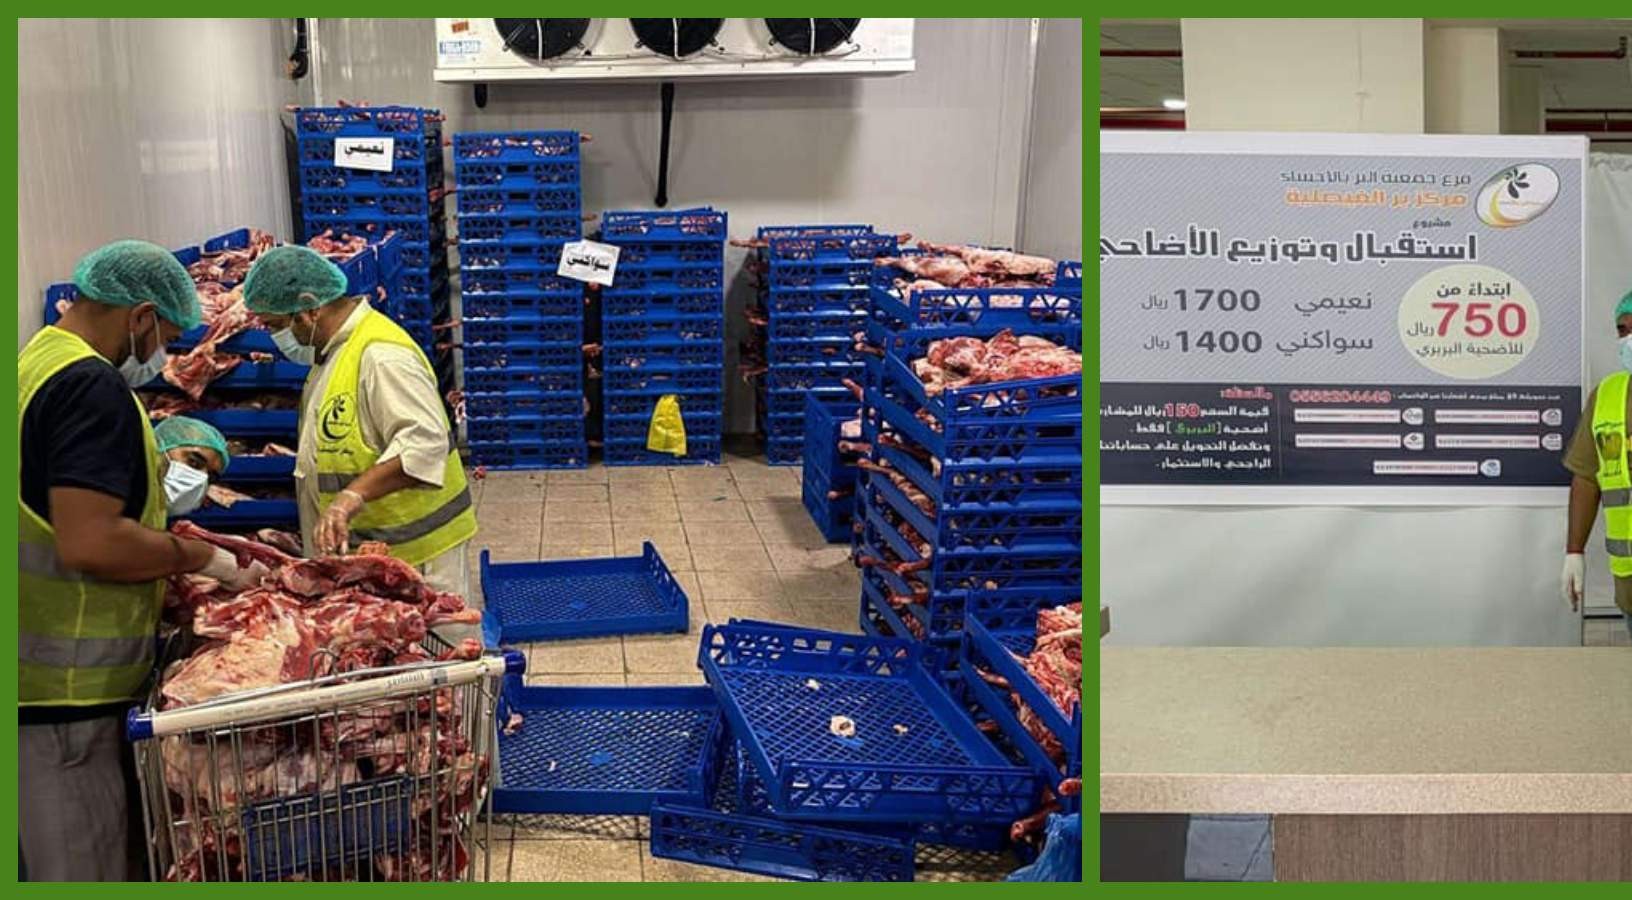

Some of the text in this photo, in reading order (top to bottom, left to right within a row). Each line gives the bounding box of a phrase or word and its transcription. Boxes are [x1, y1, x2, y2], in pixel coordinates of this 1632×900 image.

[1415, 188, 1468, 208] مركز
[1227, 236, 1339, 264] وتوزيع
[1344, 231, 1478, 265] استقبال
[1140, 288, 1373, 317] نعيمي 1700 ريال
[1436, 284, 1462, 299] من
[1406, 302, 1527, 338] 750 ريال
[1142, 329, 1374, 357] سواكني 1400 ريال
[1163, 402, 1200, 419] 150
